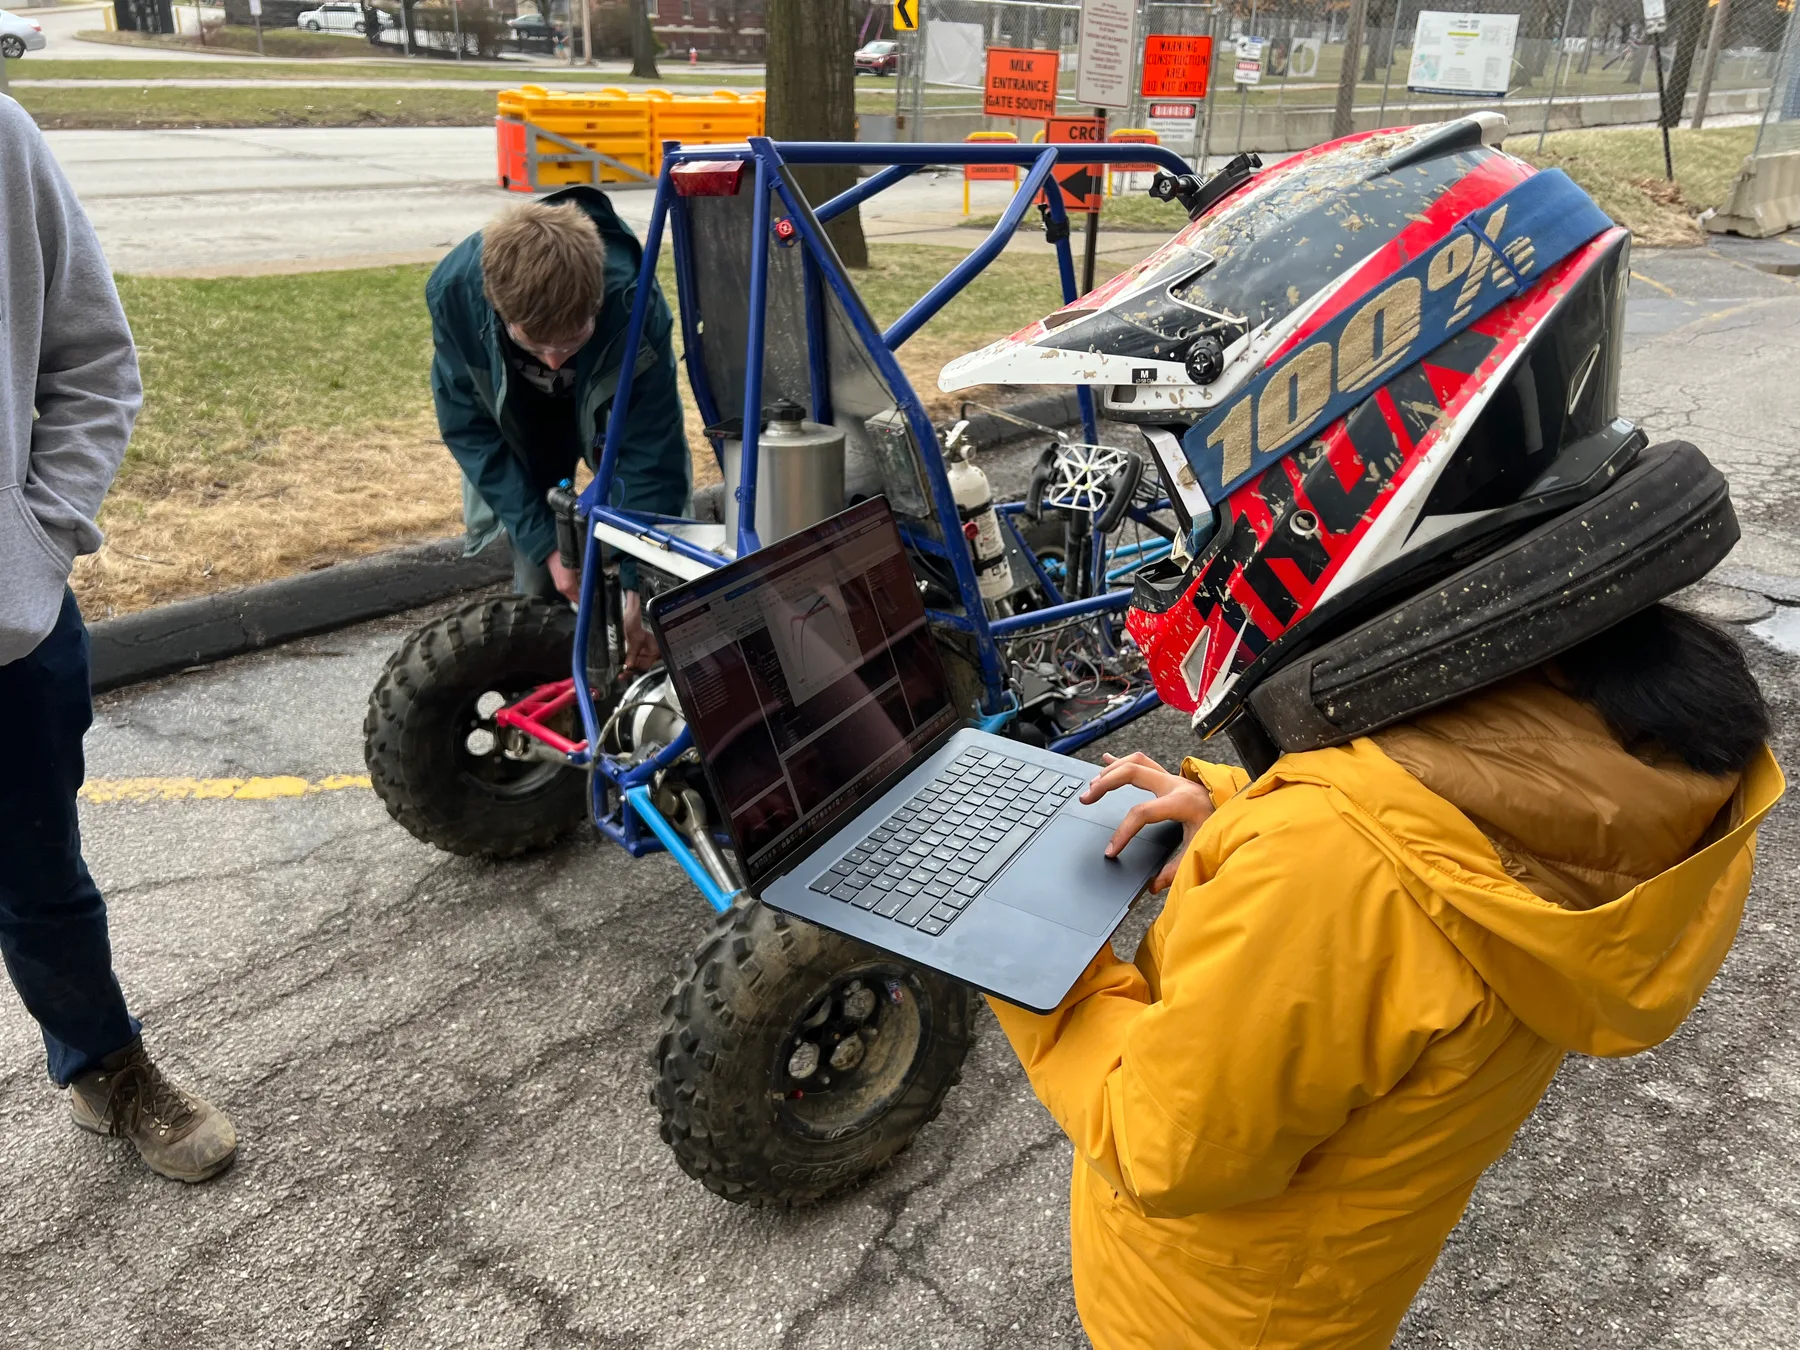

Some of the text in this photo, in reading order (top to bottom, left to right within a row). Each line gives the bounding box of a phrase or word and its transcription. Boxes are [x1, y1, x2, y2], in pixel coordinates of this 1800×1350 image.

[1160, 41, 1198, 52] WARNING
[1146, 54, 1208, 65] CONSTRUCTION
[1165, 68, 1187, 78] AREA
[992, 76, 1049, 93] ENTRANCE
[1160, 81, 1176, 91] NOT
[1178, 81, 1204, 92] ENTER
[986, 95, 1053, 112] GATE SOUTH
[1206, 203, 1535, 488] 100%
[1141, 370, 1149, 379] M
